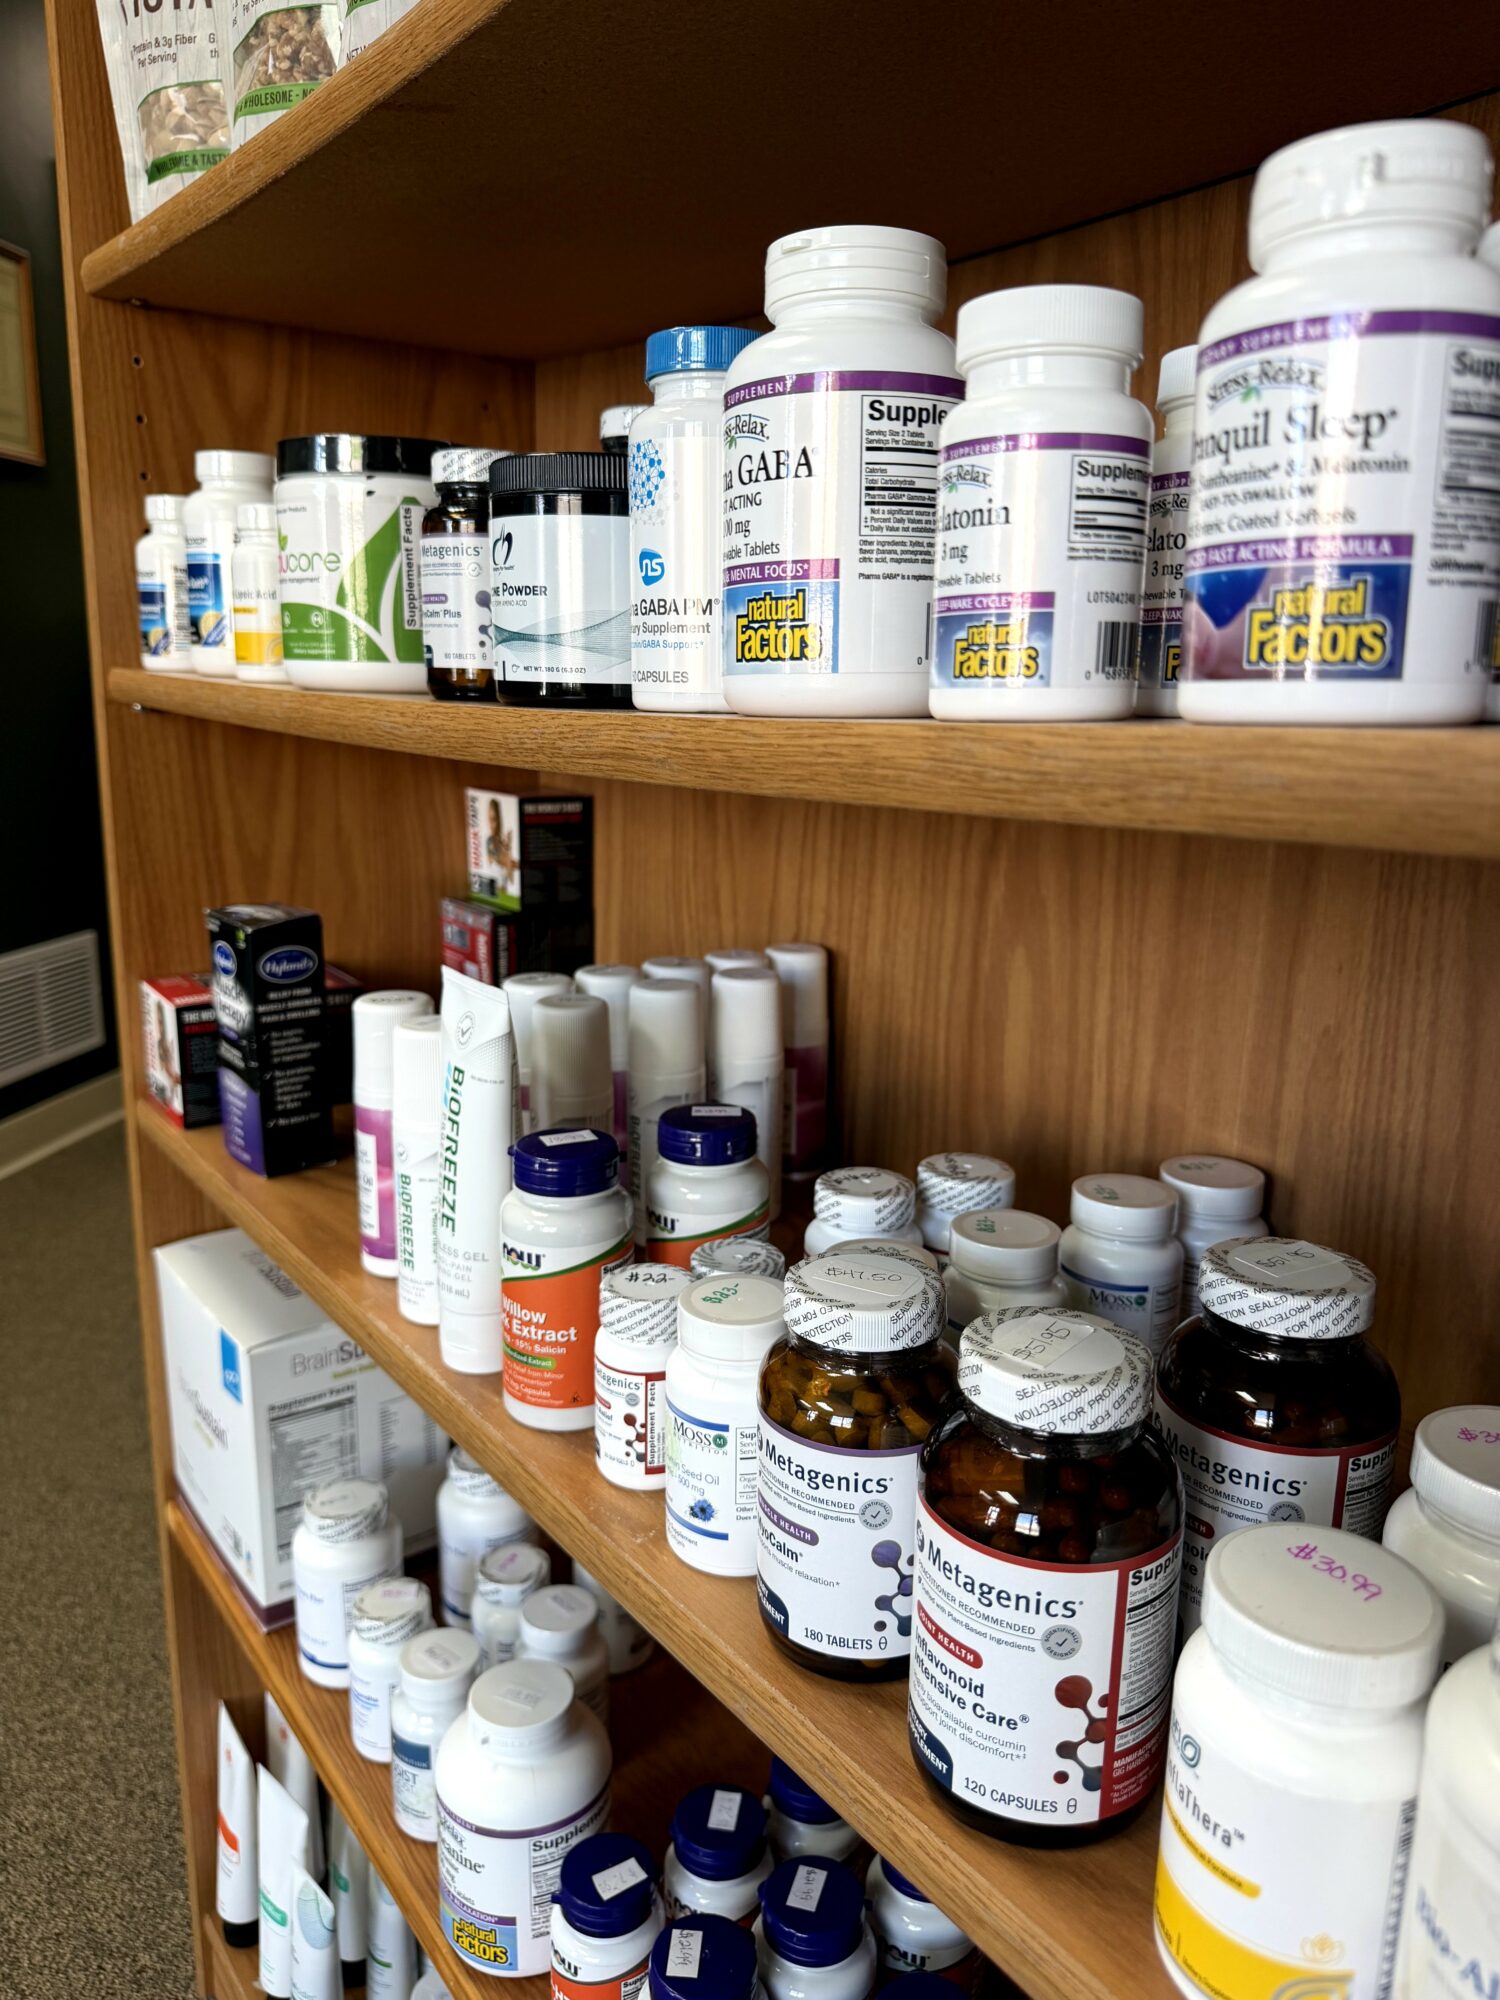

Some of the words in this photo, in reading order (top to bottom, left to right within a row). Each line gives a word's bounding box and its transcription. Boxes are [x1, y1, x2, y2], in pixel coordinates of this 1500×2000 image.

[162, 35, 172, 50] 3g
[174, 34, 197, 47] Fiber
[148, 51, 177, 66] Serving
[239, 90, 293, 112] WHOLESOME
[865, 429, 887, 437] Serving
[888, 429, 899, 437] Size
[907, 430, 925, 438] Tablets
[865, 438, 889, 446] Servings
[881, 478, 915, 486] Carbohydrate
[729, 492, 762, 512] ACTING
[403, 507, 413, 544] Facts
[735, 520, 751, 538] mg
[744, 541, 780, 556] Tablets
[949, 544, 968, 563] mg
[731, 567, 760, 582] MENTAL
[965, 573, 1001, 585] Tablets
[1152, 561, 1158, 577] 3
[1162, 563, 1184, 580] mg
[405, 548, 417, 627] Supplement
[502, 583, 547, 597] POWDER
[1274, 578, 1365, 614] natural
[443, 609, 461, 619] Plus
[640, 598, 679, 616] GABA
[749, 591, 804, 620] natural
[642, 622, 711, 637] Supplement
[737, 618, 820, 660] Factors
[968, 622, 1025, 644] natural
[1248, 610, 1387, 664] Factors
[452, 652, 476, 660] TABLETS
[955, 639, 1038, 678] Factors
[637, 671, 689, 683] CAPSULES
[464, 1251, 489, 1262] GEL
[1250, 1295, 1288, 1313] SEALED
[512, 1320, 578, 1342] Extract
[1285, 1321, 1308, 1336] FOR
[534, 1344, 567, 1354] Salicin
[528, 1357, 552, 1367] Extract
[1060, 1408, 1087, 1426] FOR
[674, 1416, 712, 1446] MOSS
[765, 1438, 888, 1494] Metagenics
[1165, 1428, 1302, 1496] Metagenics
[678, 1475, 689, 1488] 500
[691, 1484, 705, 1496] mg
[682, 1464, 702, 1481] Seed
[705, 1473, 719, 1486] Oil
[792, 1486, 855, 1510] RECOMMENDED
[1193, 1478, 1263, 1510] RECOMMENDED
[783, 1495, 816, 1516] Plant-Based
[818, 1510, 855, 1524] Ingredients
[1221, 1506, 1263, 1524] Ingredients
[780, 1519, 811, 1541] HEALTH
[772, 1553, 793, 1572] muscle
[1285, 1541, 1385, 1603] $30.99
[928, 1539, 1077, 1619] Metagenics
[958, 1601, 1036, 1635] RECOMMENDED
[804, 1627, 823, 1643] 180
[826, 1634, 872, 1650] TABLETS
[919, 1609, 936, 1636] JOINT
[938, 1633, 974, 1662] HEALTH
[948, 1610, 987, 1639] Plant-Based
[989, 1634, 1036, 1652] Ingredients
[915, 1625, 985, 1698] Inflavonoid
[914, 1646, 967, 1710] Intensive
[927, 1693, 974, 1733] bioavailable
[975, 1729, 1027, 1752] curcumin
[939, 1715, 958, 1738] joint
[964, 1777, 986, 1797] 120
[990, 1789, 1058, 1813] CAPSULES
[460, 1920, 496, 1943] natural
[453, 1923, 508, 1963] Factors
